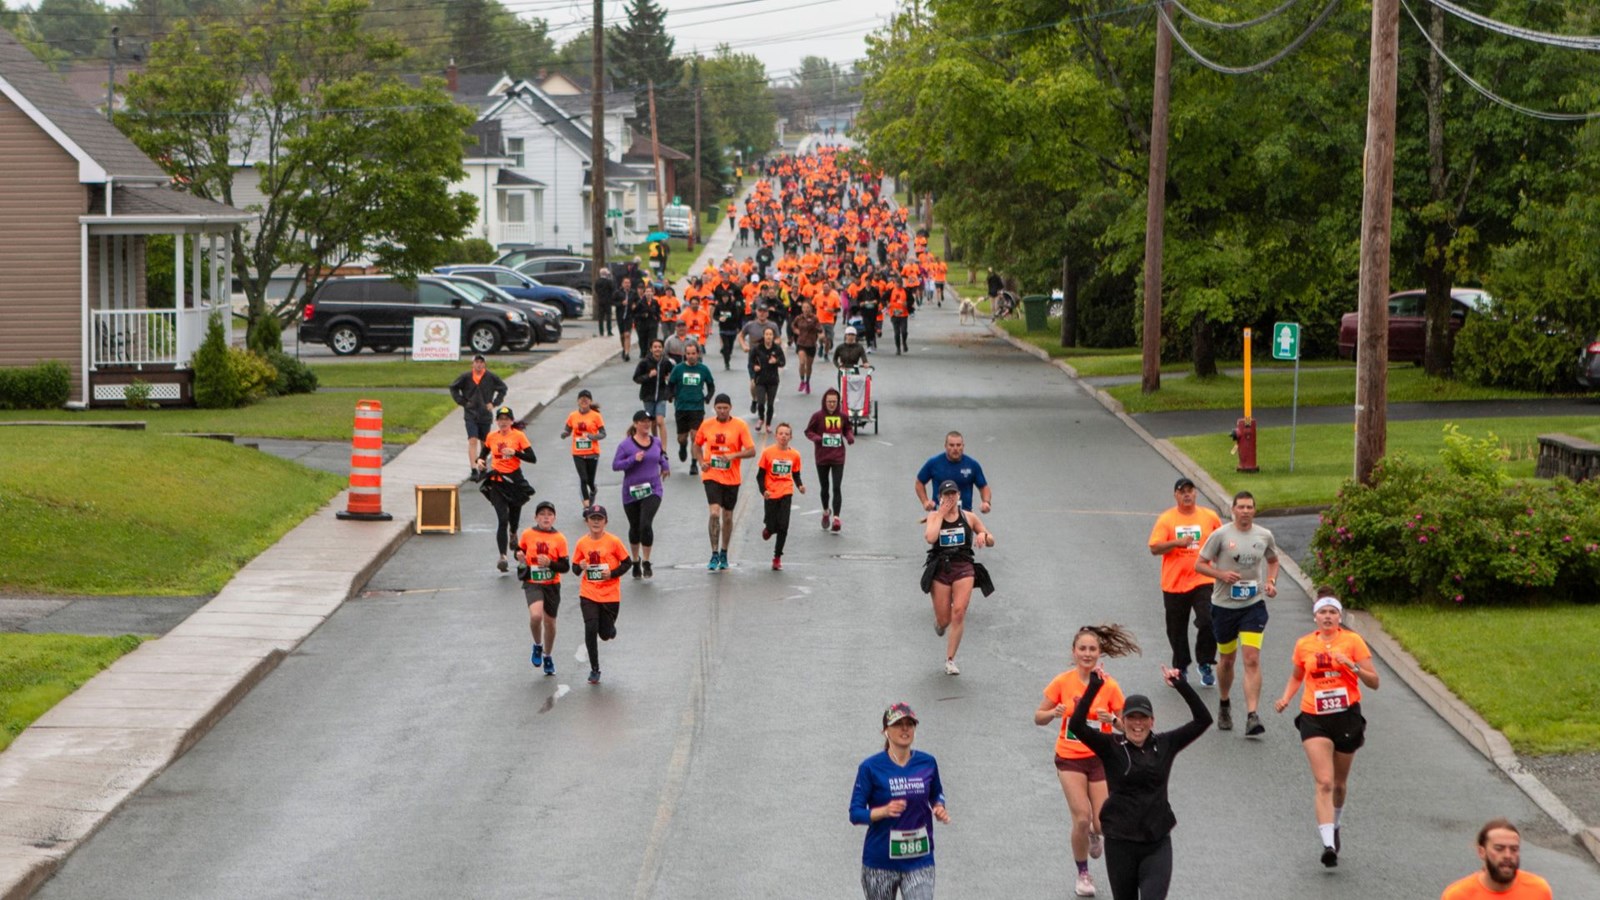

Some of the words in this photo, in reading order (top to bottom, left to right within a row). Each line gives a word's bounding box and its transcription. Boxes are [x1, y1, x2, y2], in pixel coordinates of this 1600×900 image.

[948, 535, 958, 543] 74
[537, 571, 552, 580] 710
[1239, 587, 1250, 597] 30
[1321, 697, 1342, 710] 332
[888, 776, 907, 786] DEMI
[889, 781, 925, 792] MARATHON
[899, 841, 922, 854] 986
